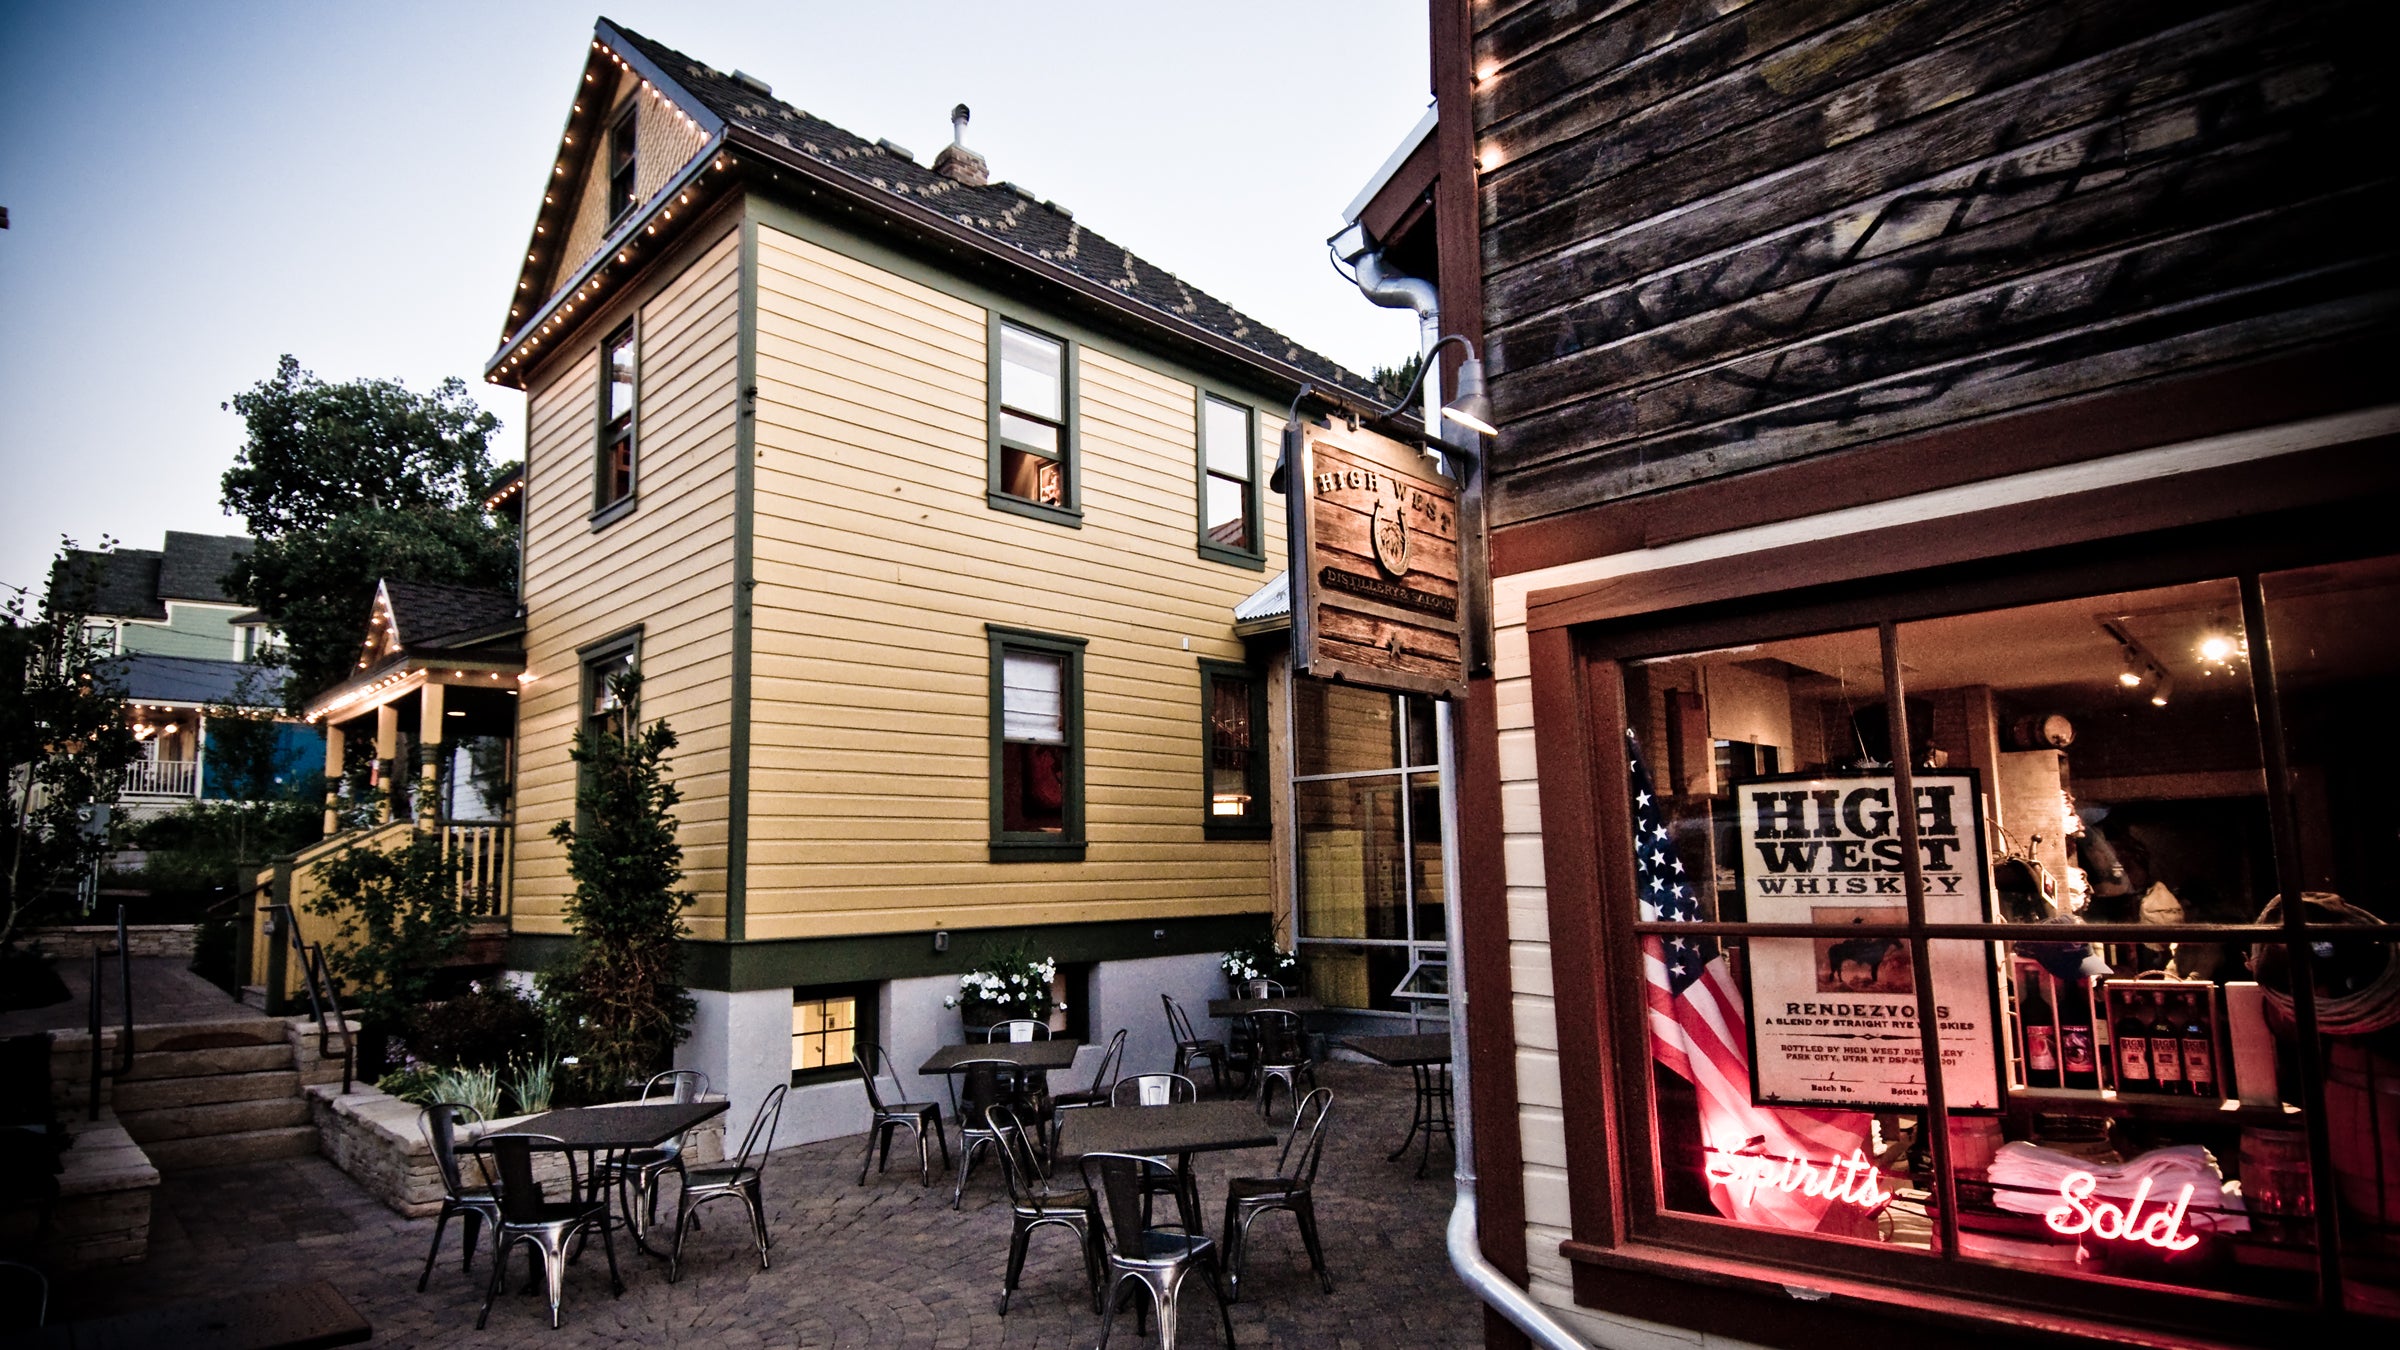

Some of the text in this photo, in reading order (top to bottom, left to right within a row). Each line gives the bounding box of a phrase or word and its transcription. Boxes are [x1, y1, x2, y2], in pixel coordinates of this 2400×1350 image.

[1317, 470, 1451, 533] HIGH WEST
[1327, 569, 1456, 611] DISTILLERY & SALOON
[1752, 786, 1958, 839] HIGH
[1755, 838, 1960, 873] WEST
[1776, 1018, 1812, 1026] BLEND
[1815, 1019, 1830, 1027] OF
[1833, 1019, 1888, 1028] STRAIGHT
[1892, 1021, 1914, 1029] RYE
[1787, 1002, 1950, 1019] RENDEZVOS
[1780, 1045, 1824, 1053] BOTTLED
[1870, 1047, 1900, 1055] WEST
[1786, 1053, 1810, 1061] PARK
[1842, 1055, 1869, 1064] UTAH
[1811, 1084, 1855, 1093] Batch No.
[1891, 1088, 1919, 1096] Bottle
[1706, 1134, 1892, 1208] Spirits
[2046, 1170, 2200, 1251] Sold
